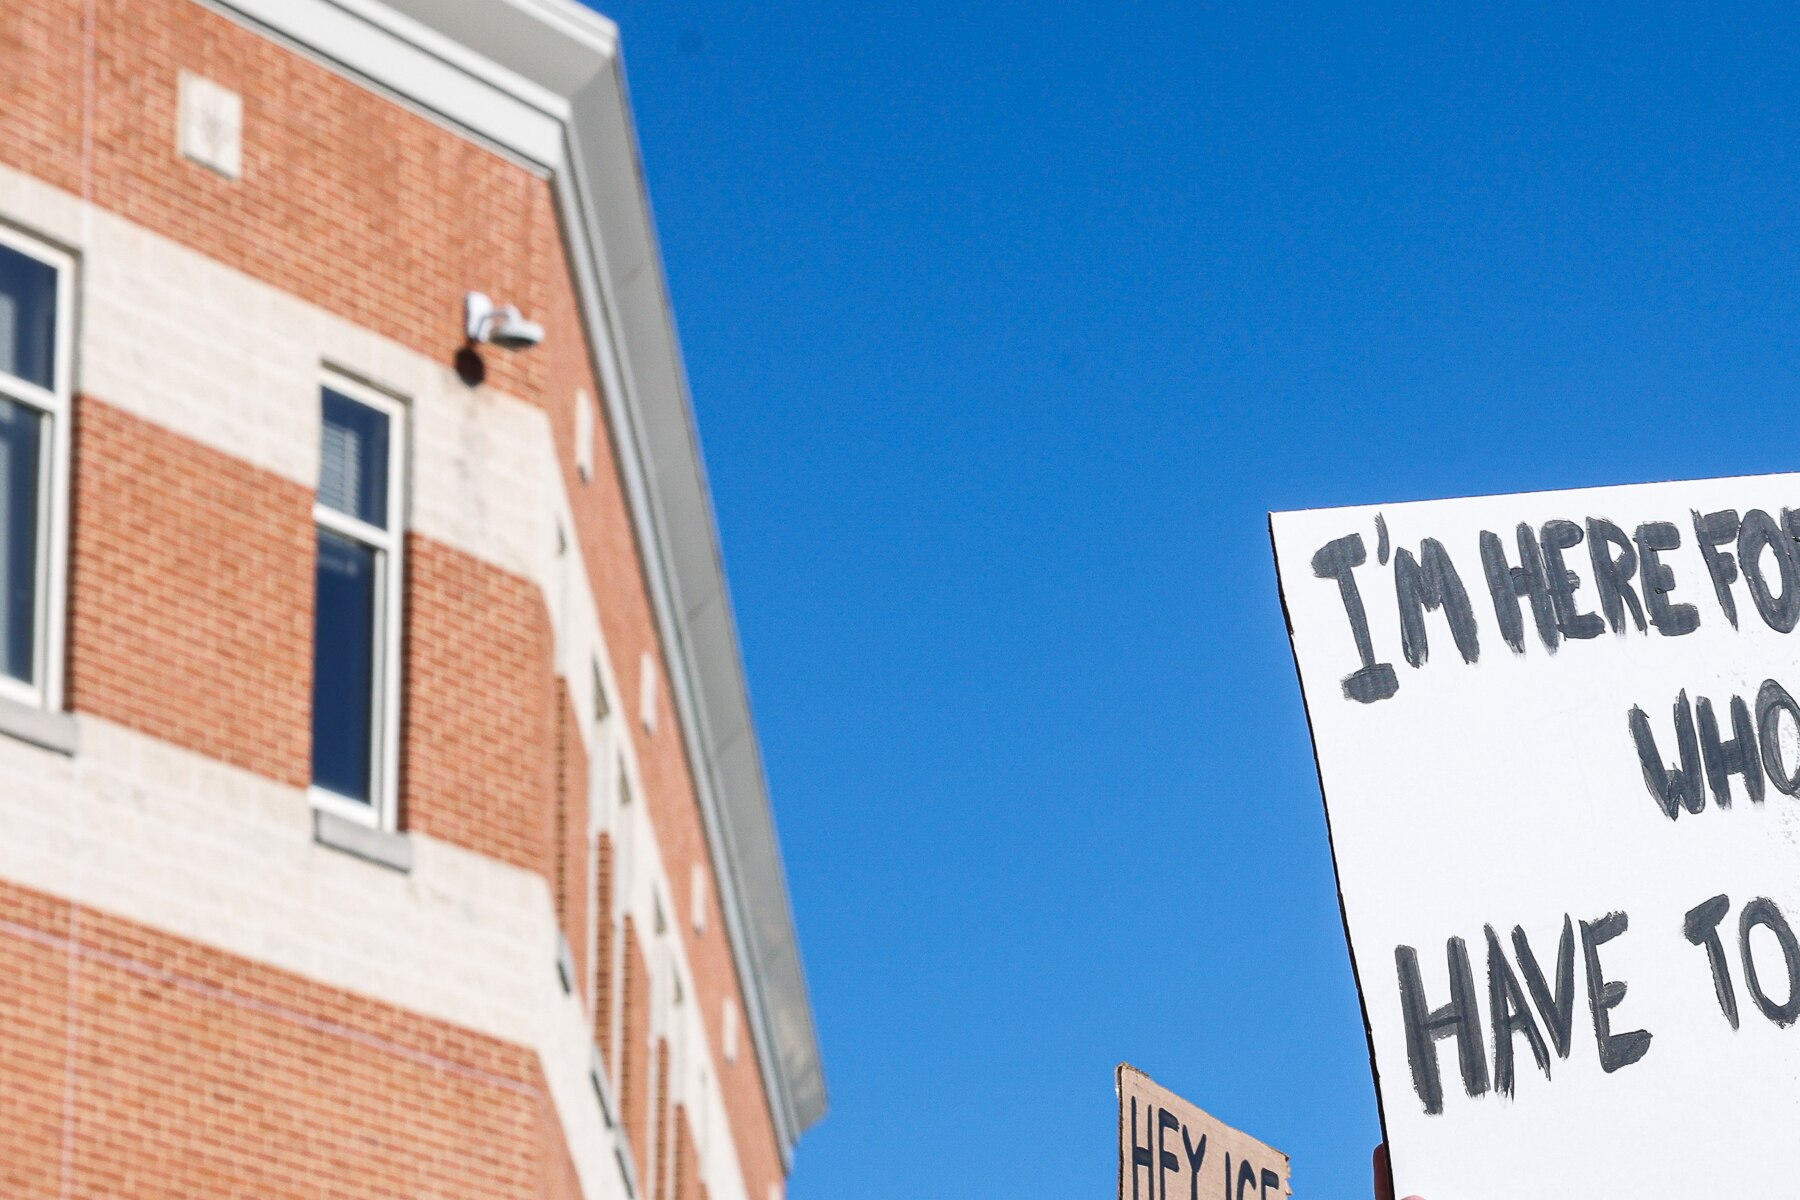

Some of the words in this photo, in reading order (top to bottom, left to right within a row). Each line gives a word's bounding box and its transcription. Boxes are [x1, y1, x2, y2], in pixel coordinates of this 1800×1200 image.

[1311, 512, 1480, 704] I'M
[1480, 516, 1699, 656] HERE
[1394, 911, 1654, 1115] HAVE
